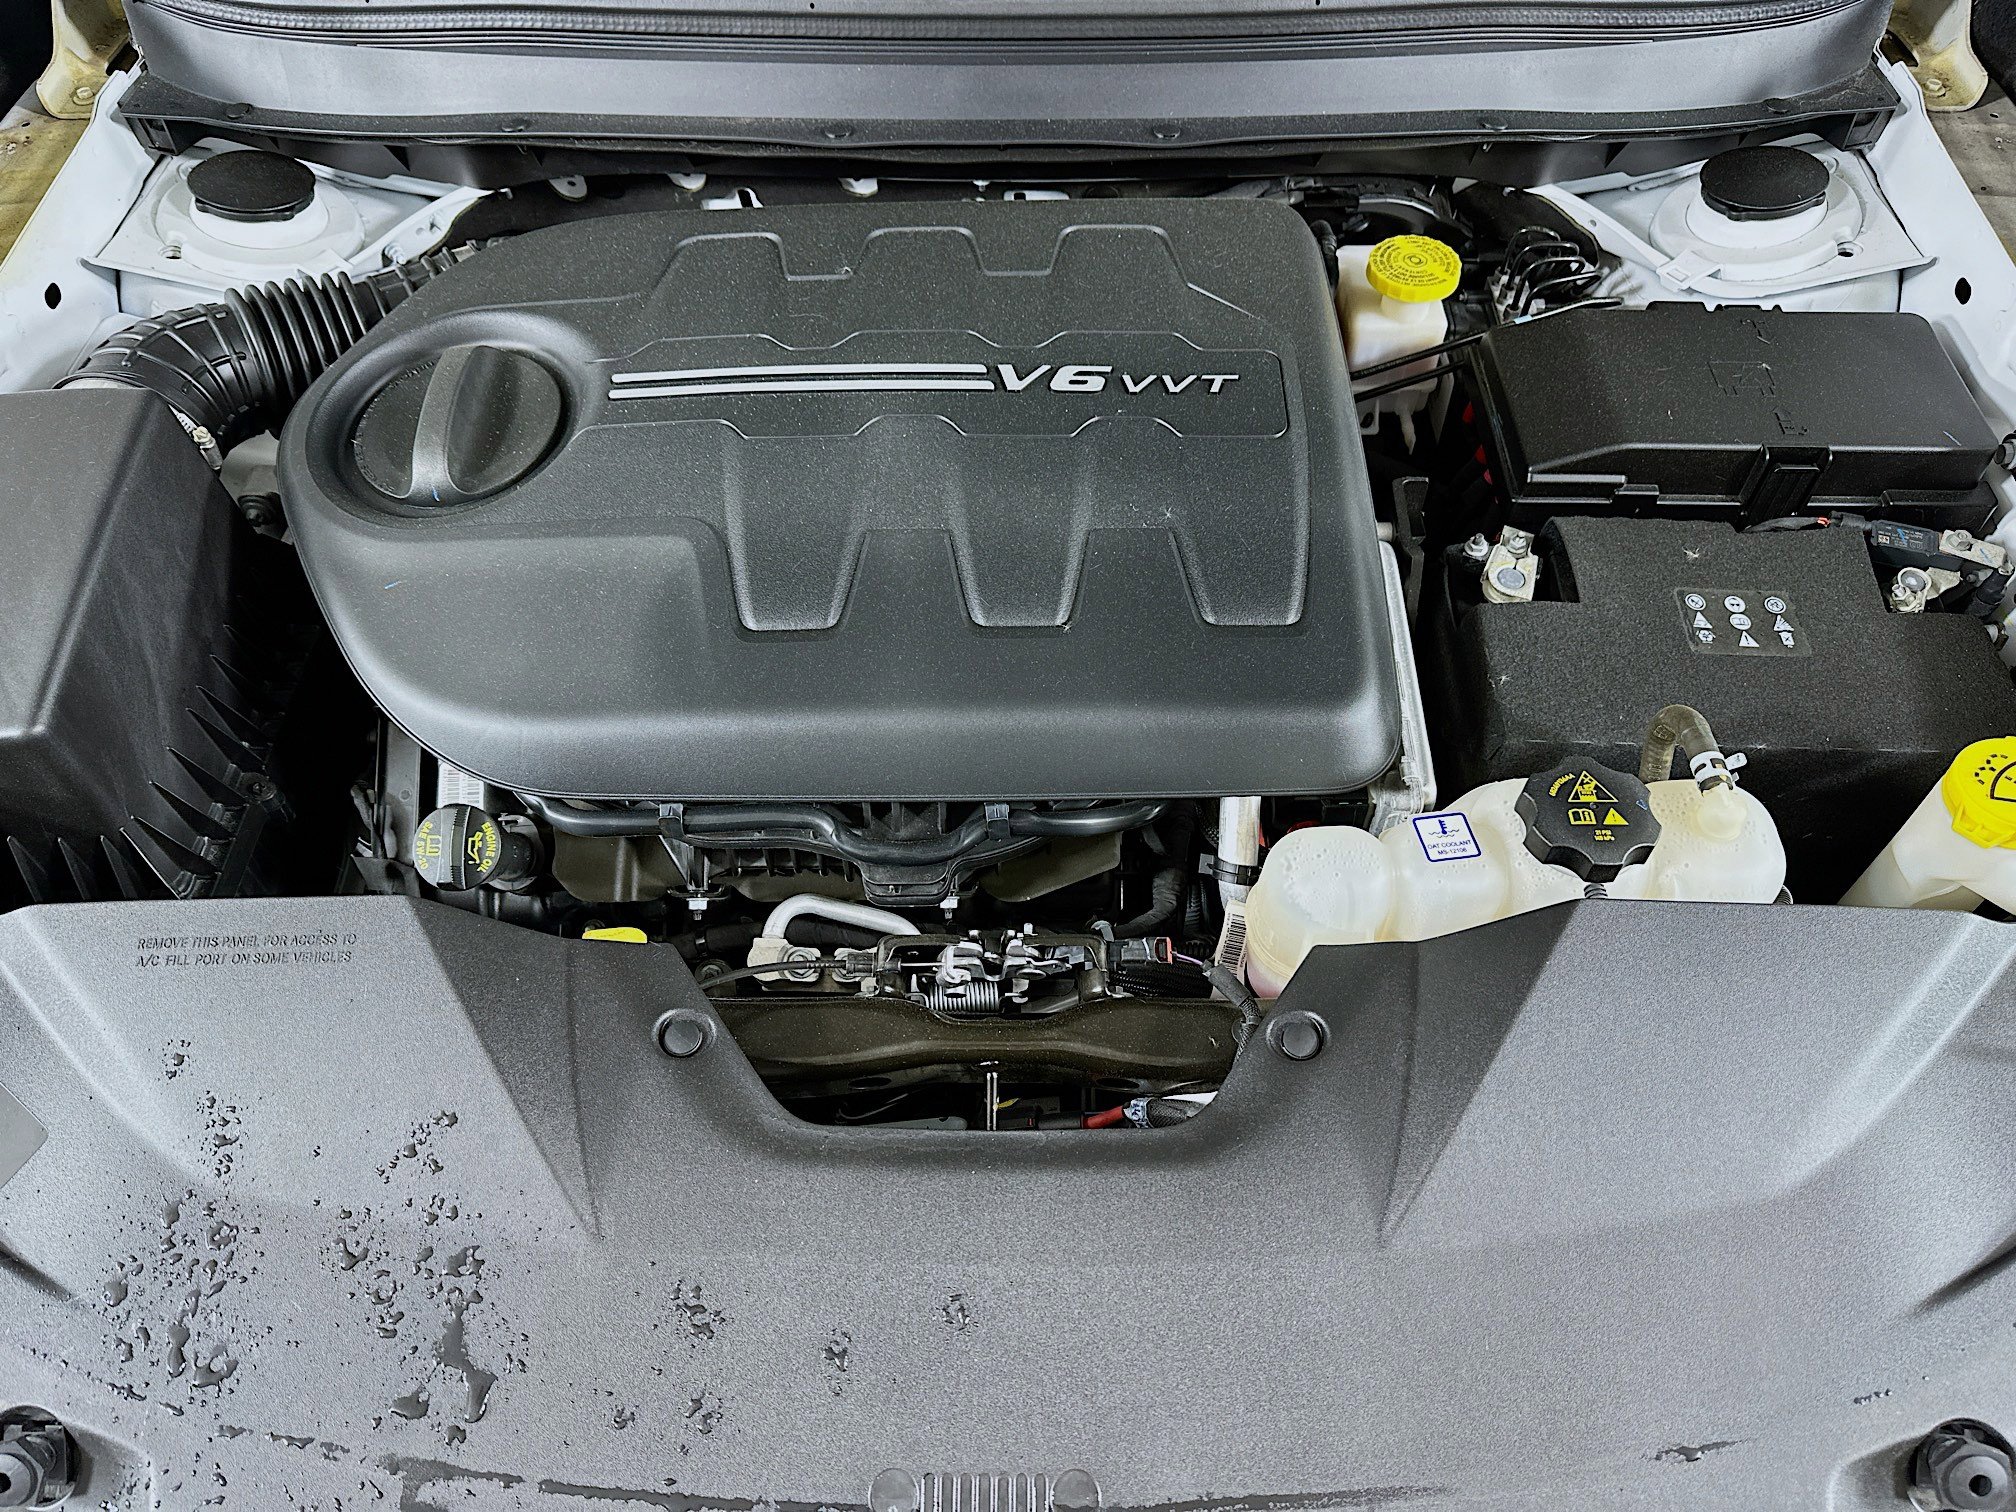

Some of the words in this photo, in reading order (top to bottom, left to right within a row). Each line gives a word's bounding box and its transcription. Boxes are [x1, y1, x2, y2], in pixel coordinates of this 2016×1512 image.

[998, 364, 1113, 393] V6
[1121, 374, 1239, 395] VVT
[481, 821, 497, 858] ENGINE
[1441, 839, 1472, 848] COOLANT
[477, 858, 493, 873] OIL
[138, 937, 188, 949] REMOVE
[192, 936, 219, 948] THIS
[222, 935, 259, 948] PANEL
[264, 934, 288, 946] FOR
[290, 933, 338, 946] ACCESS
[343, 933, 357, 945] TO
[135, 954, 160, 967] A/C
[165, 954, 189, 966] FILL
[195, 953, 228, 965] PORT
[231, 953, 251, 965] ON
[252, 952, 289, 964] SOME
[293, 951, 352, 963] VEHICLES
